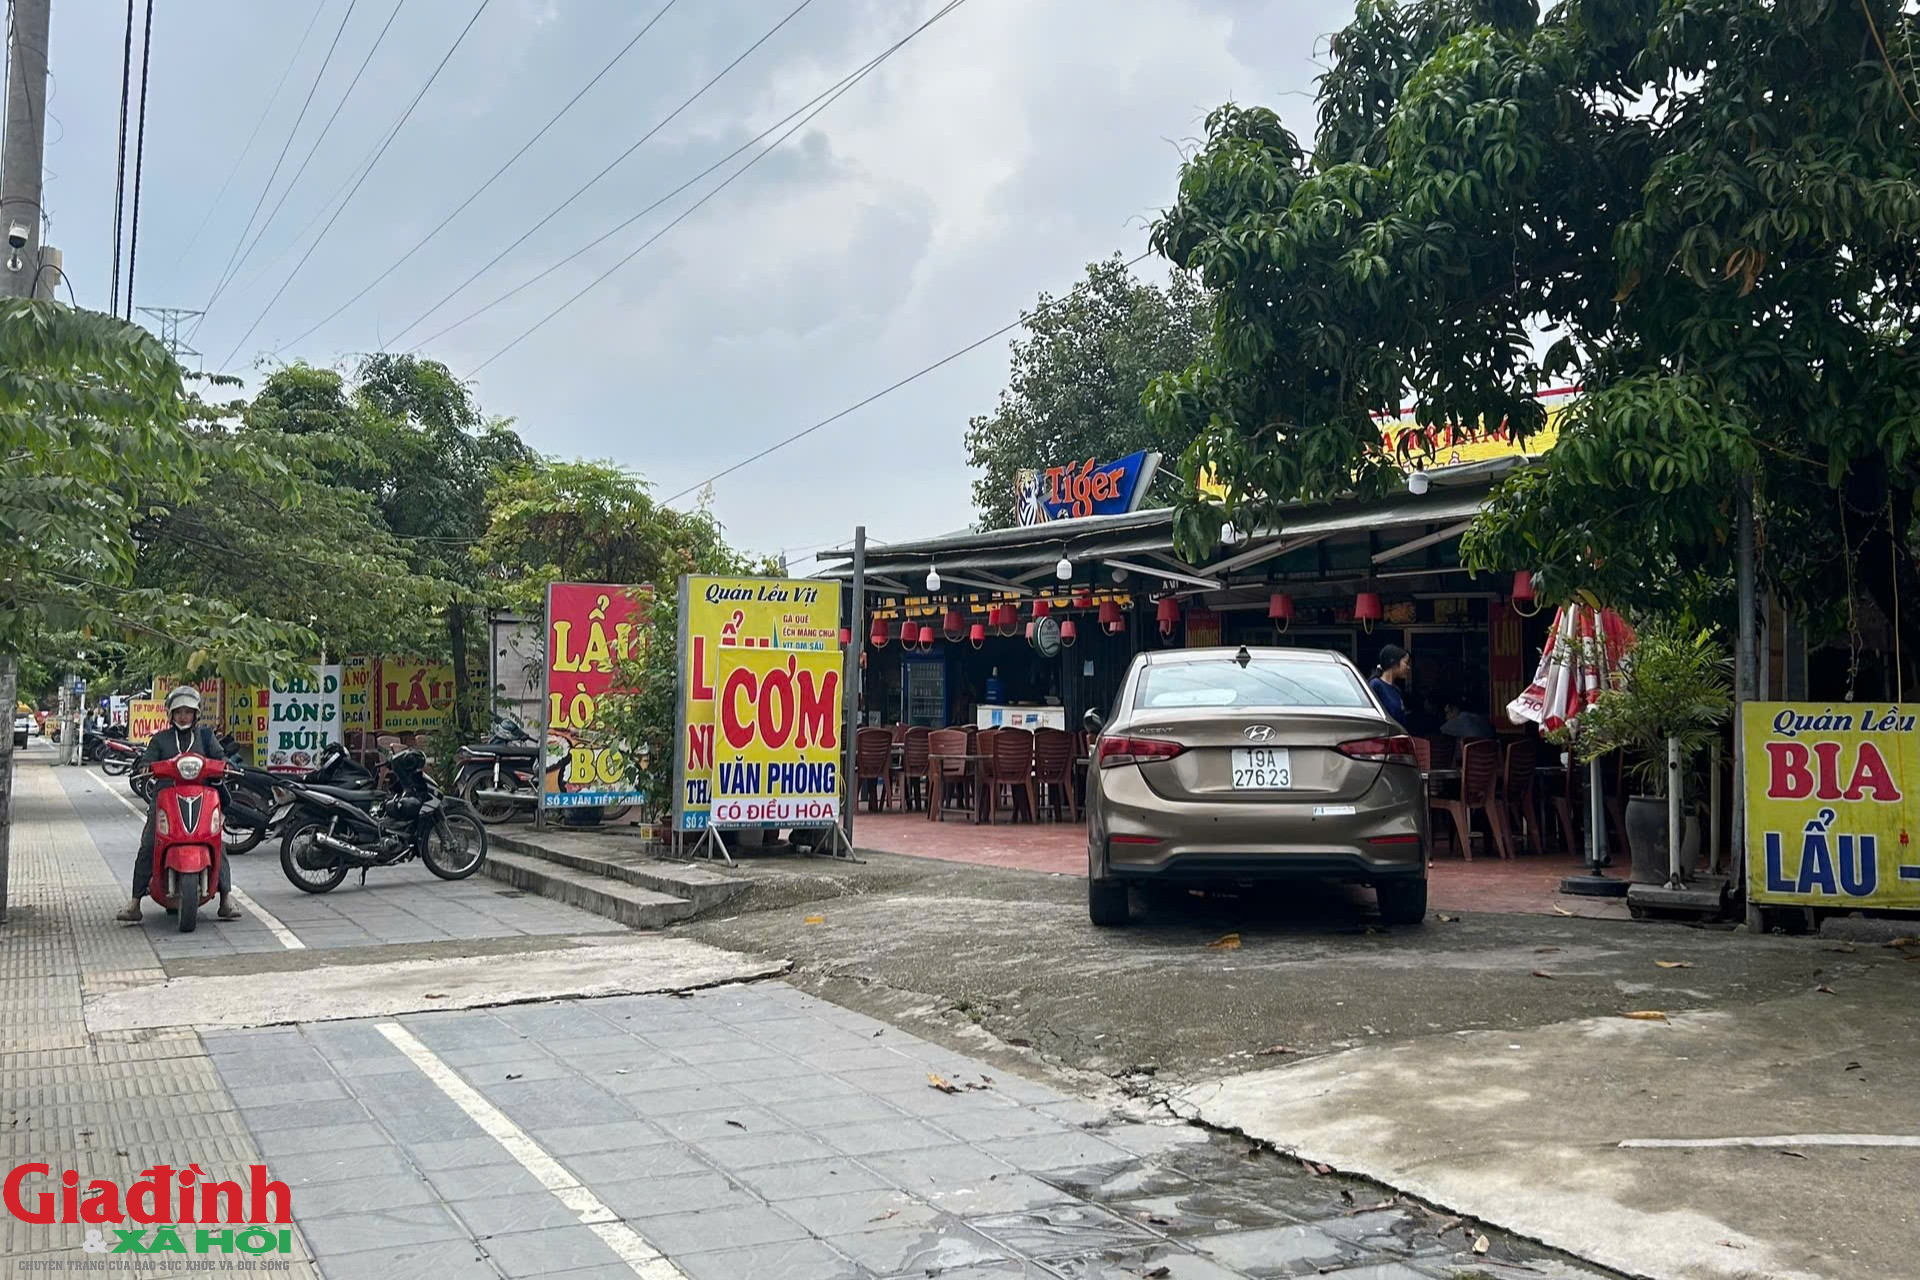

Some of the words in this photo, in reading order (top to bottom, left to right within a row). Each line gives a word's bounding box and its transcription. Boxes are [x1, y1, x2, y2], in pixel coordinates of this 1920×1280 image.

[1045, 456, 1125, 519] Tiger
[705, 583, 753, 604] Quán
[757, 583, 789, 602] Lều
[793, 587, 818, 607] Vịt
[272, 697, 337, 722] LÒNG
[721, 653, 839, 750] CƠM
[1772, 708, 1853, 737] Quán
[1860, 706, 1916, 732] Lều
[278, 726, 329, 750] BÚN
[1247, 749, 1276, 768] 19A
[719, 755, 761, 795] VĂN
[767, 754, 837, 794] PHÒNG
[1234, 768, 1290, 787] 276.23
[1765, 741, 1902, 801] BIA
[546, 793, 560, 806] SỐ
[562, 796, 569, 806] 2
[716, 801, 742, 820] CÓ
[746, 798, 790, 820] ĐIỀU
[795, 800, 835, 819] HÒA
[699, 815, 705, 828] 2
[1765, 808, 1878, 897] LẨU
